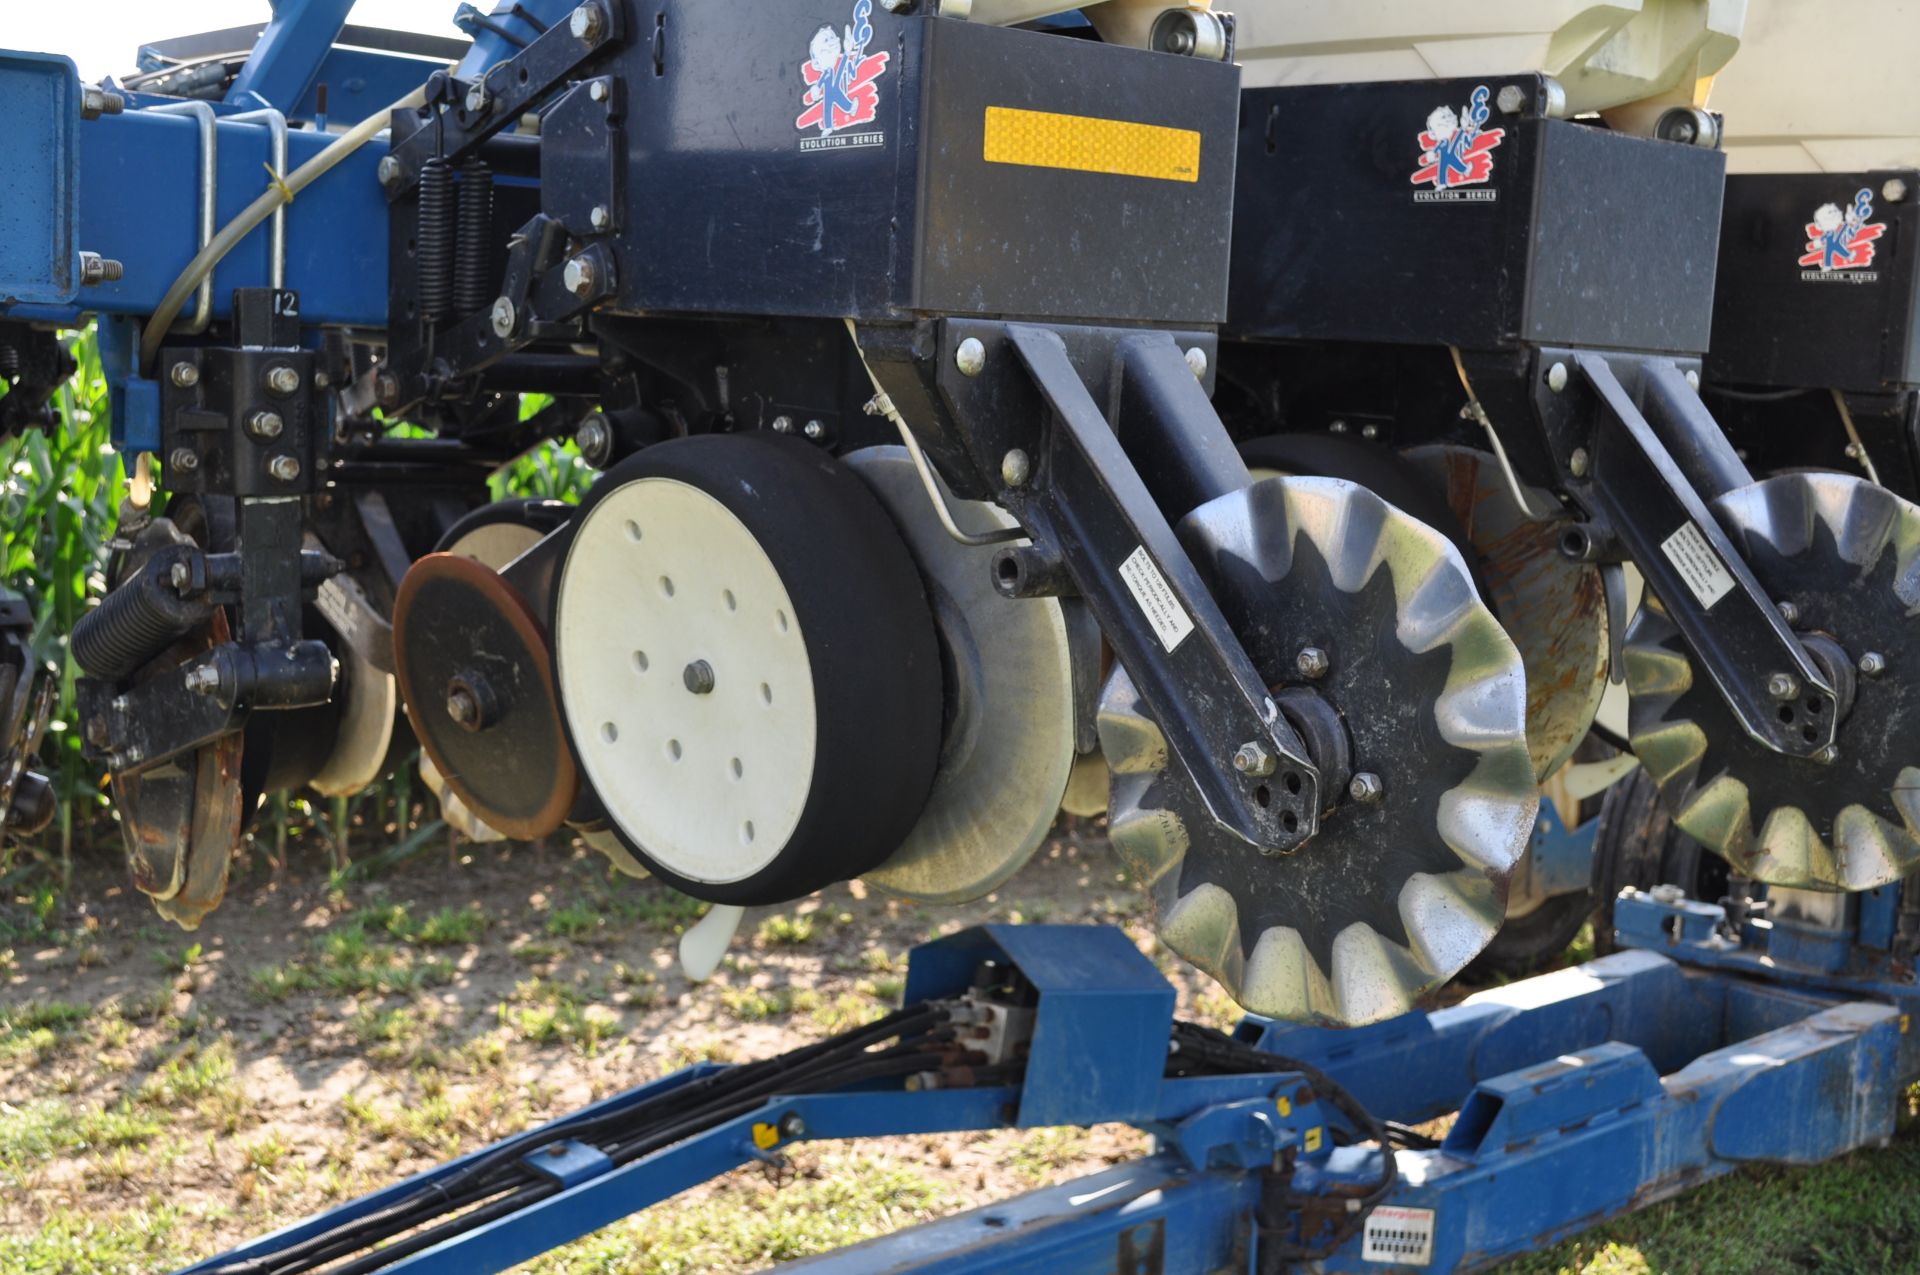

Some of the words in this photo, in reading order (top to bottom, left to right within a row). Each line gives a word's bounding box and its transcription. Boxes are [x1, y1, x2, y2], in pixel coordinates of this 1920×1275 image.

[800, 137, 847, 150] EVOLUTION
[853, 134, 884, 145] SERIES
[274, 292, 298, 317] 12
[1138, 549, 1152, 571] BOLTS
[1150, 571, 1158, 580] TO
